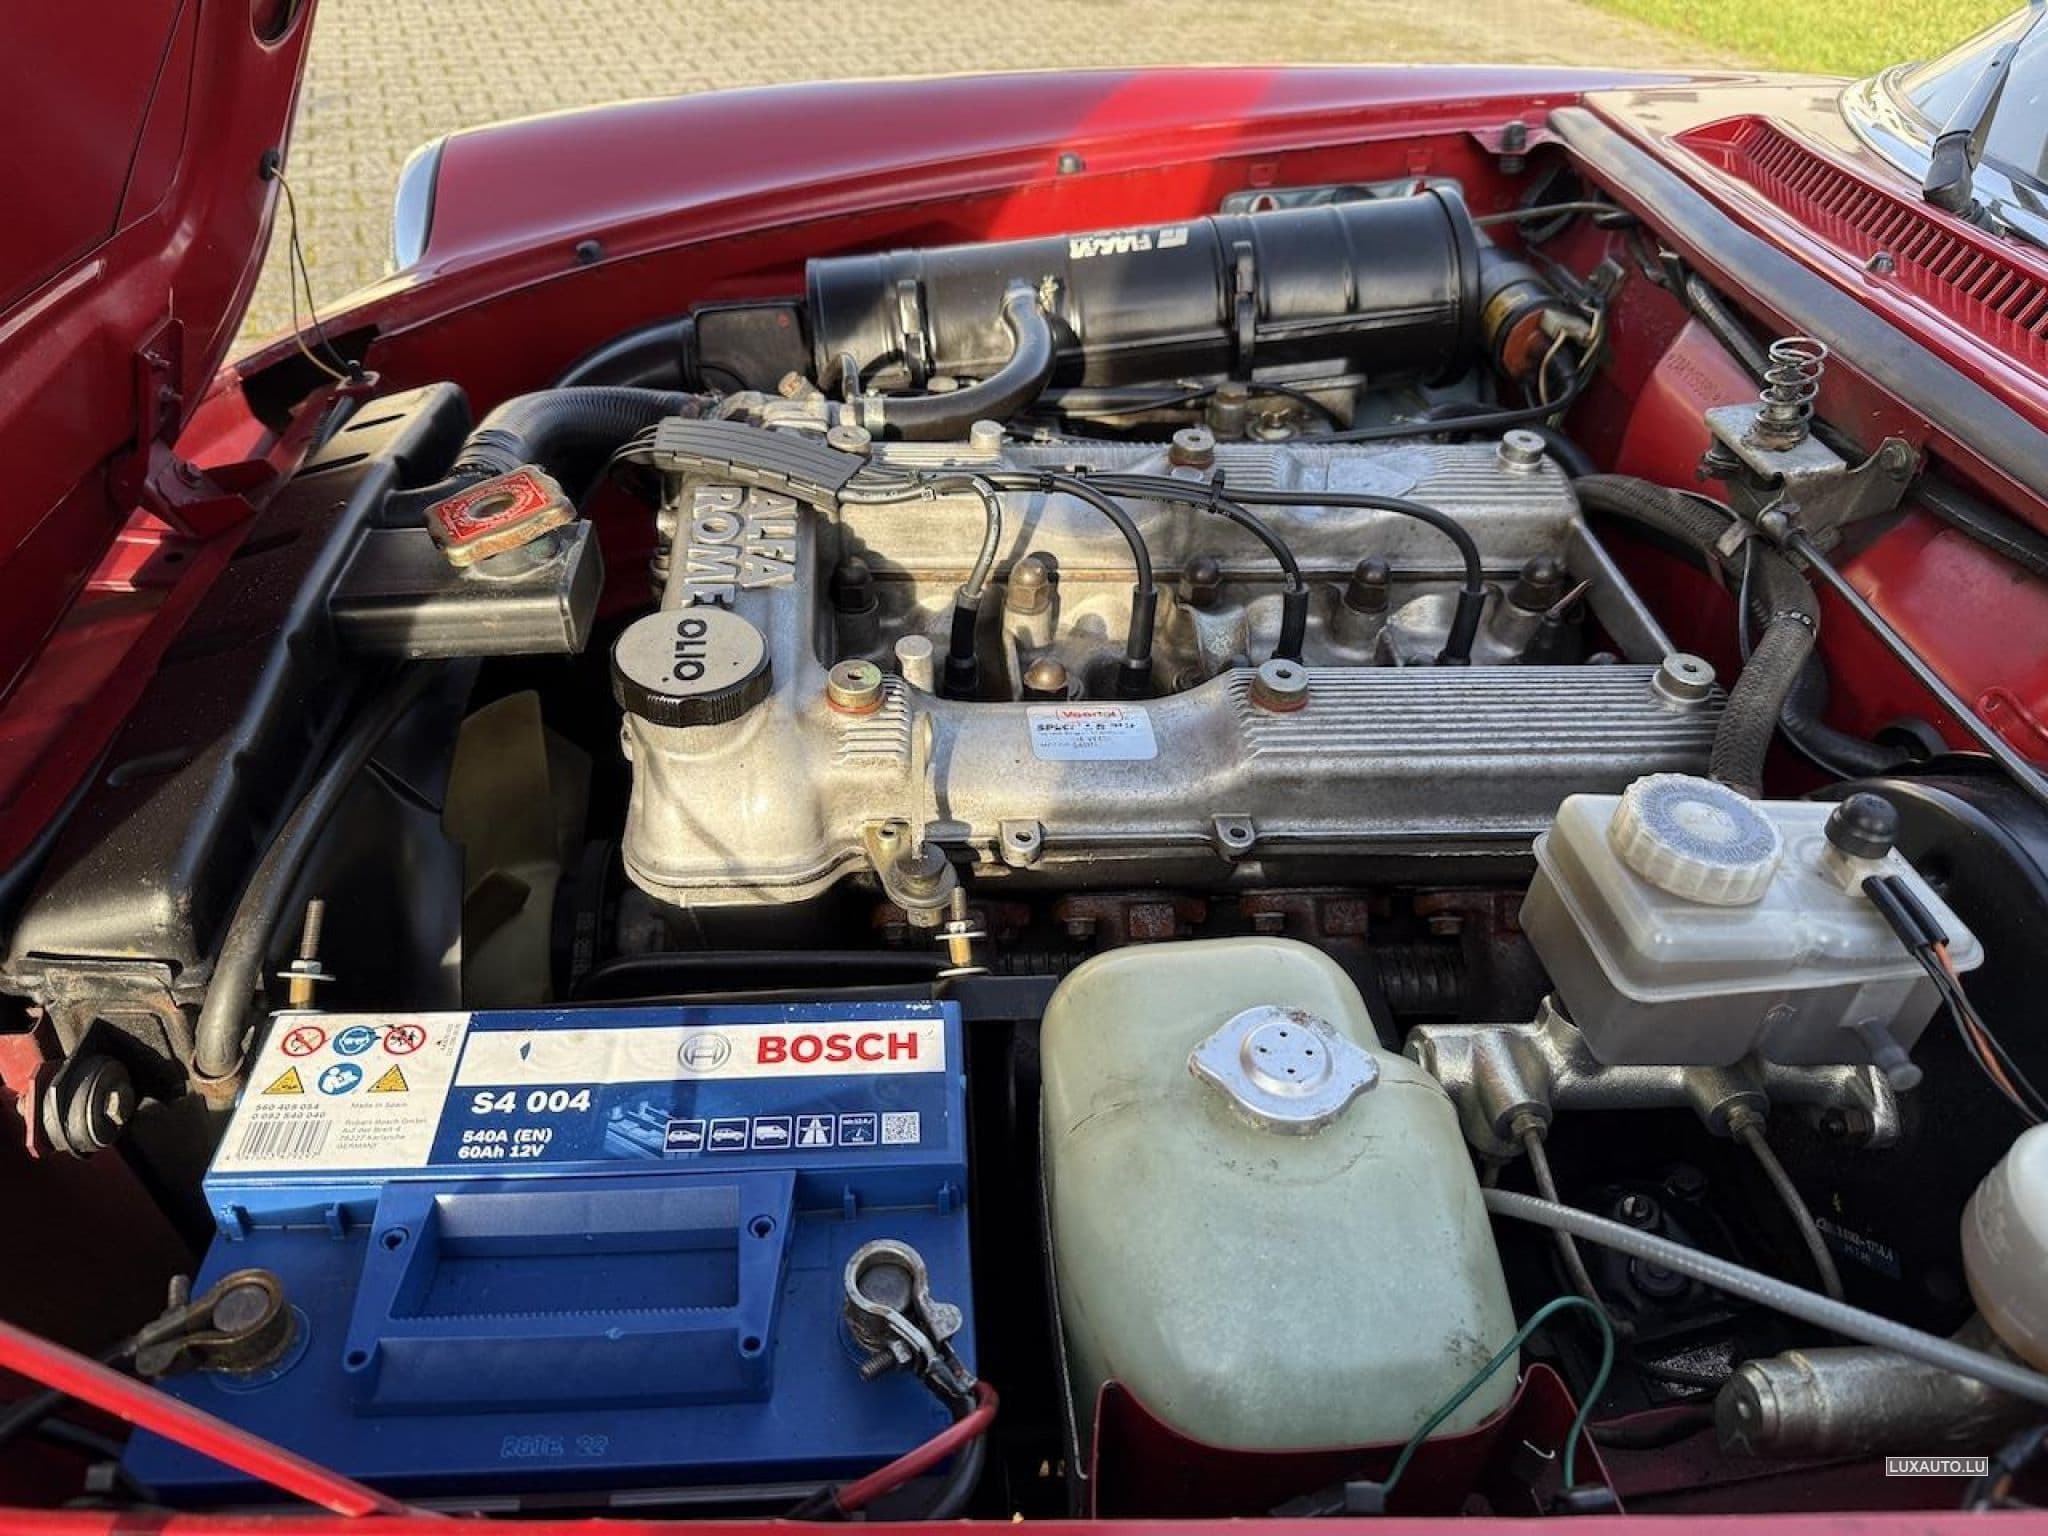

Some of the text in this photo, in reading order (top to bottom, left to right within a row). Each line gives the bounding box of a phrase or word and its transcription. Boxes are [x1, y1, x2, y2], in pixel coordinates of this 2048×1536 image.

[682, 486, 745, 606] ROME
[738, 487, 800, 589] ALFA
[673, 618, 708, 682] OLIO
[756, 1031, 918, 1065] BOSCH
[471, 1089, 591, 1114] S4 004
[458, 1144, 545, 1159] 60Ah 12V
[462, 1127, 553, 1144] 540A (EN)
